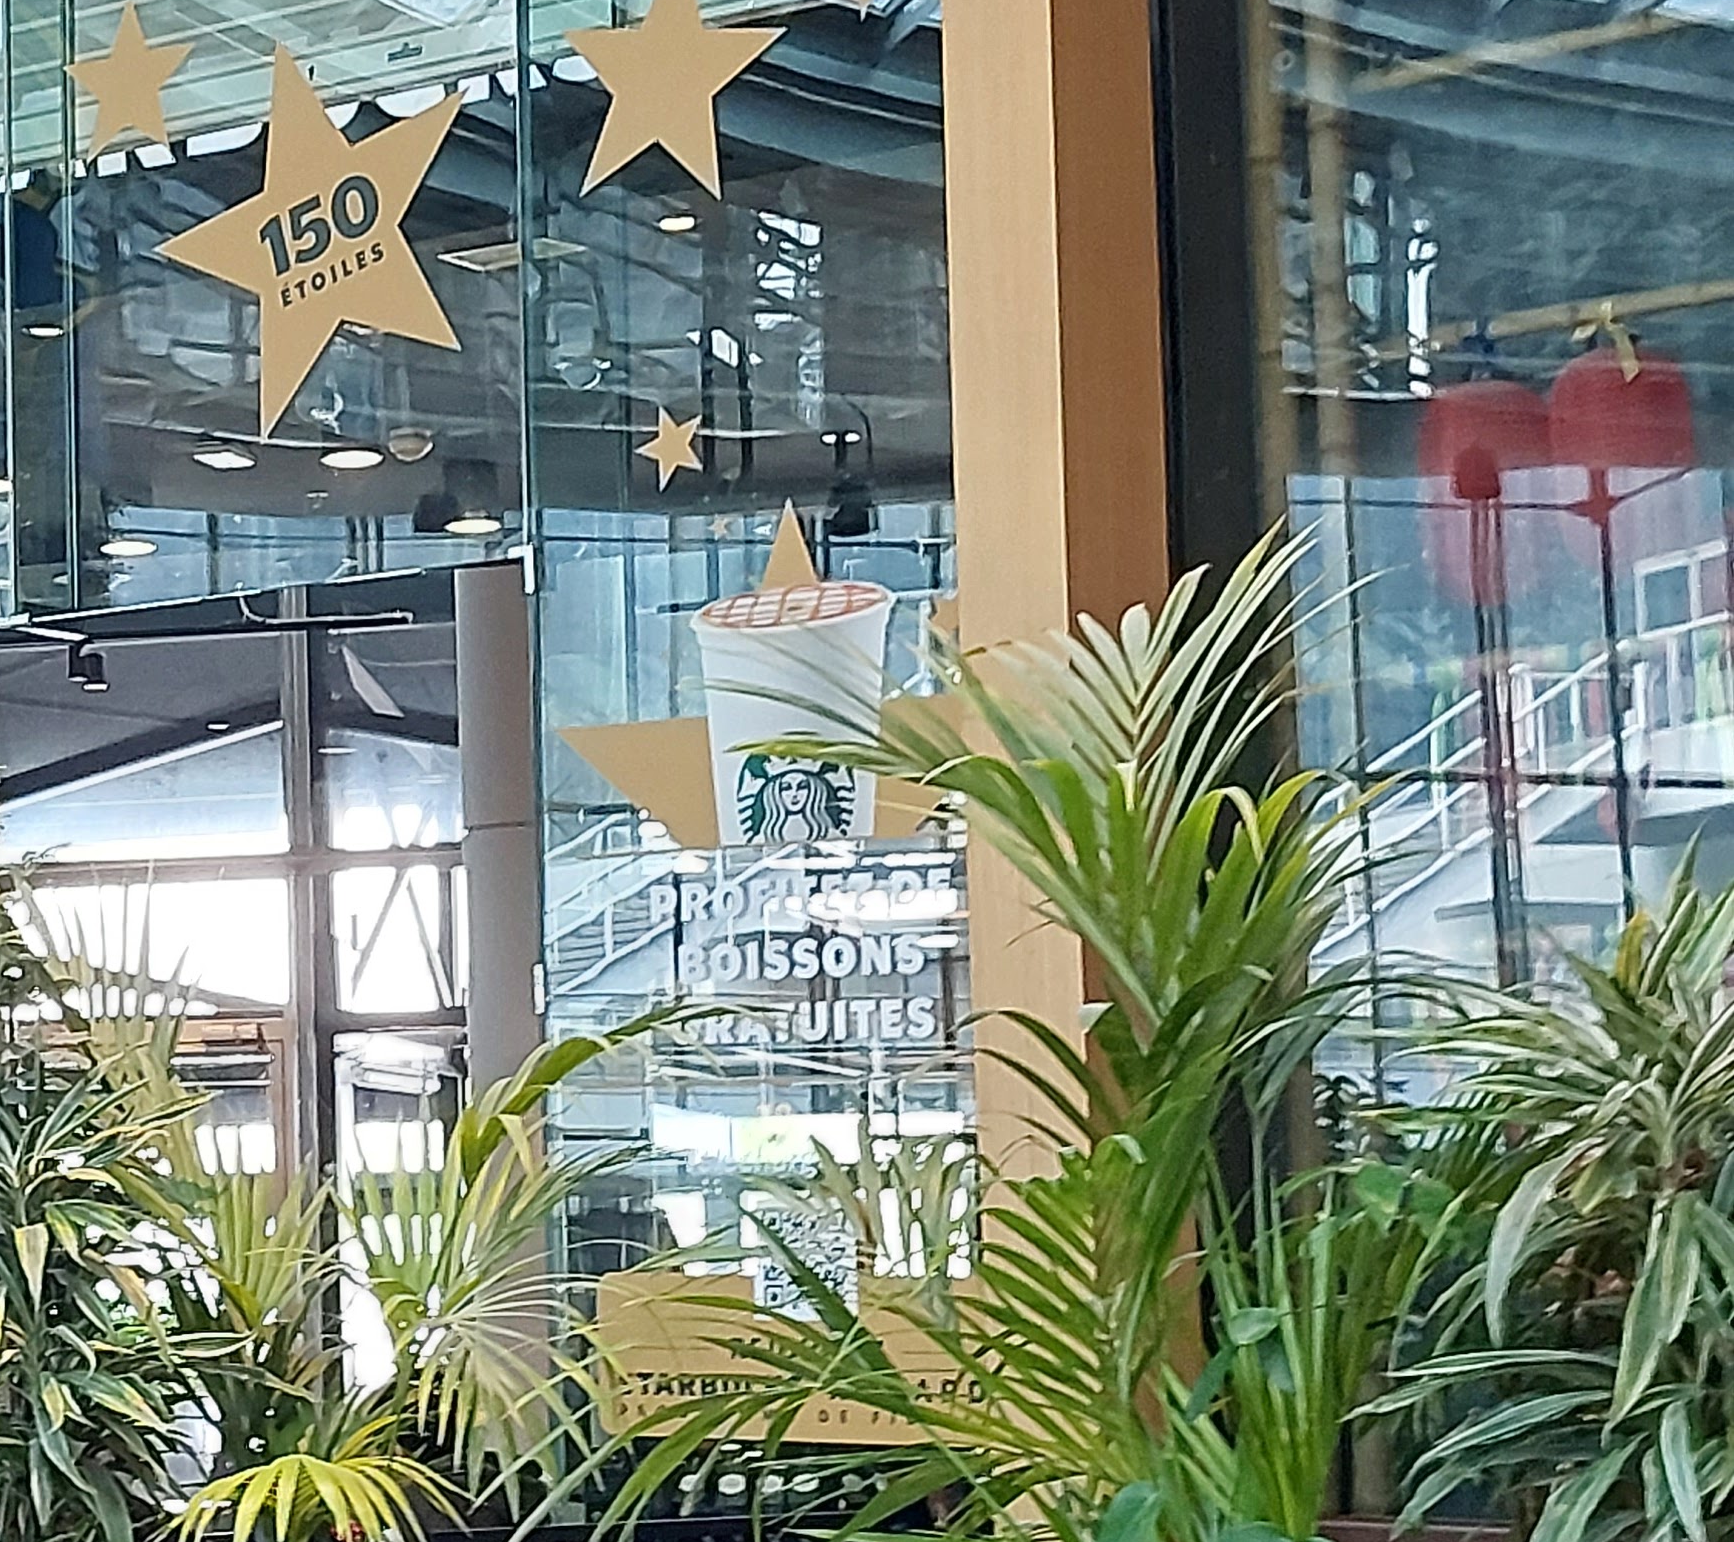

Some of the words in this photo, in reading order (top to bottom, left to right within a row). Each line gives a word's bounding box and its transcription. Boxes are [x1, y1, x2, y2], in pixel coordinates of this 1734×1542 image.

[259, 175, 379, 276] 150
[281, 243, 384, 307] ÉTOILES
[678, 934, 926, 984] BOISSONS
